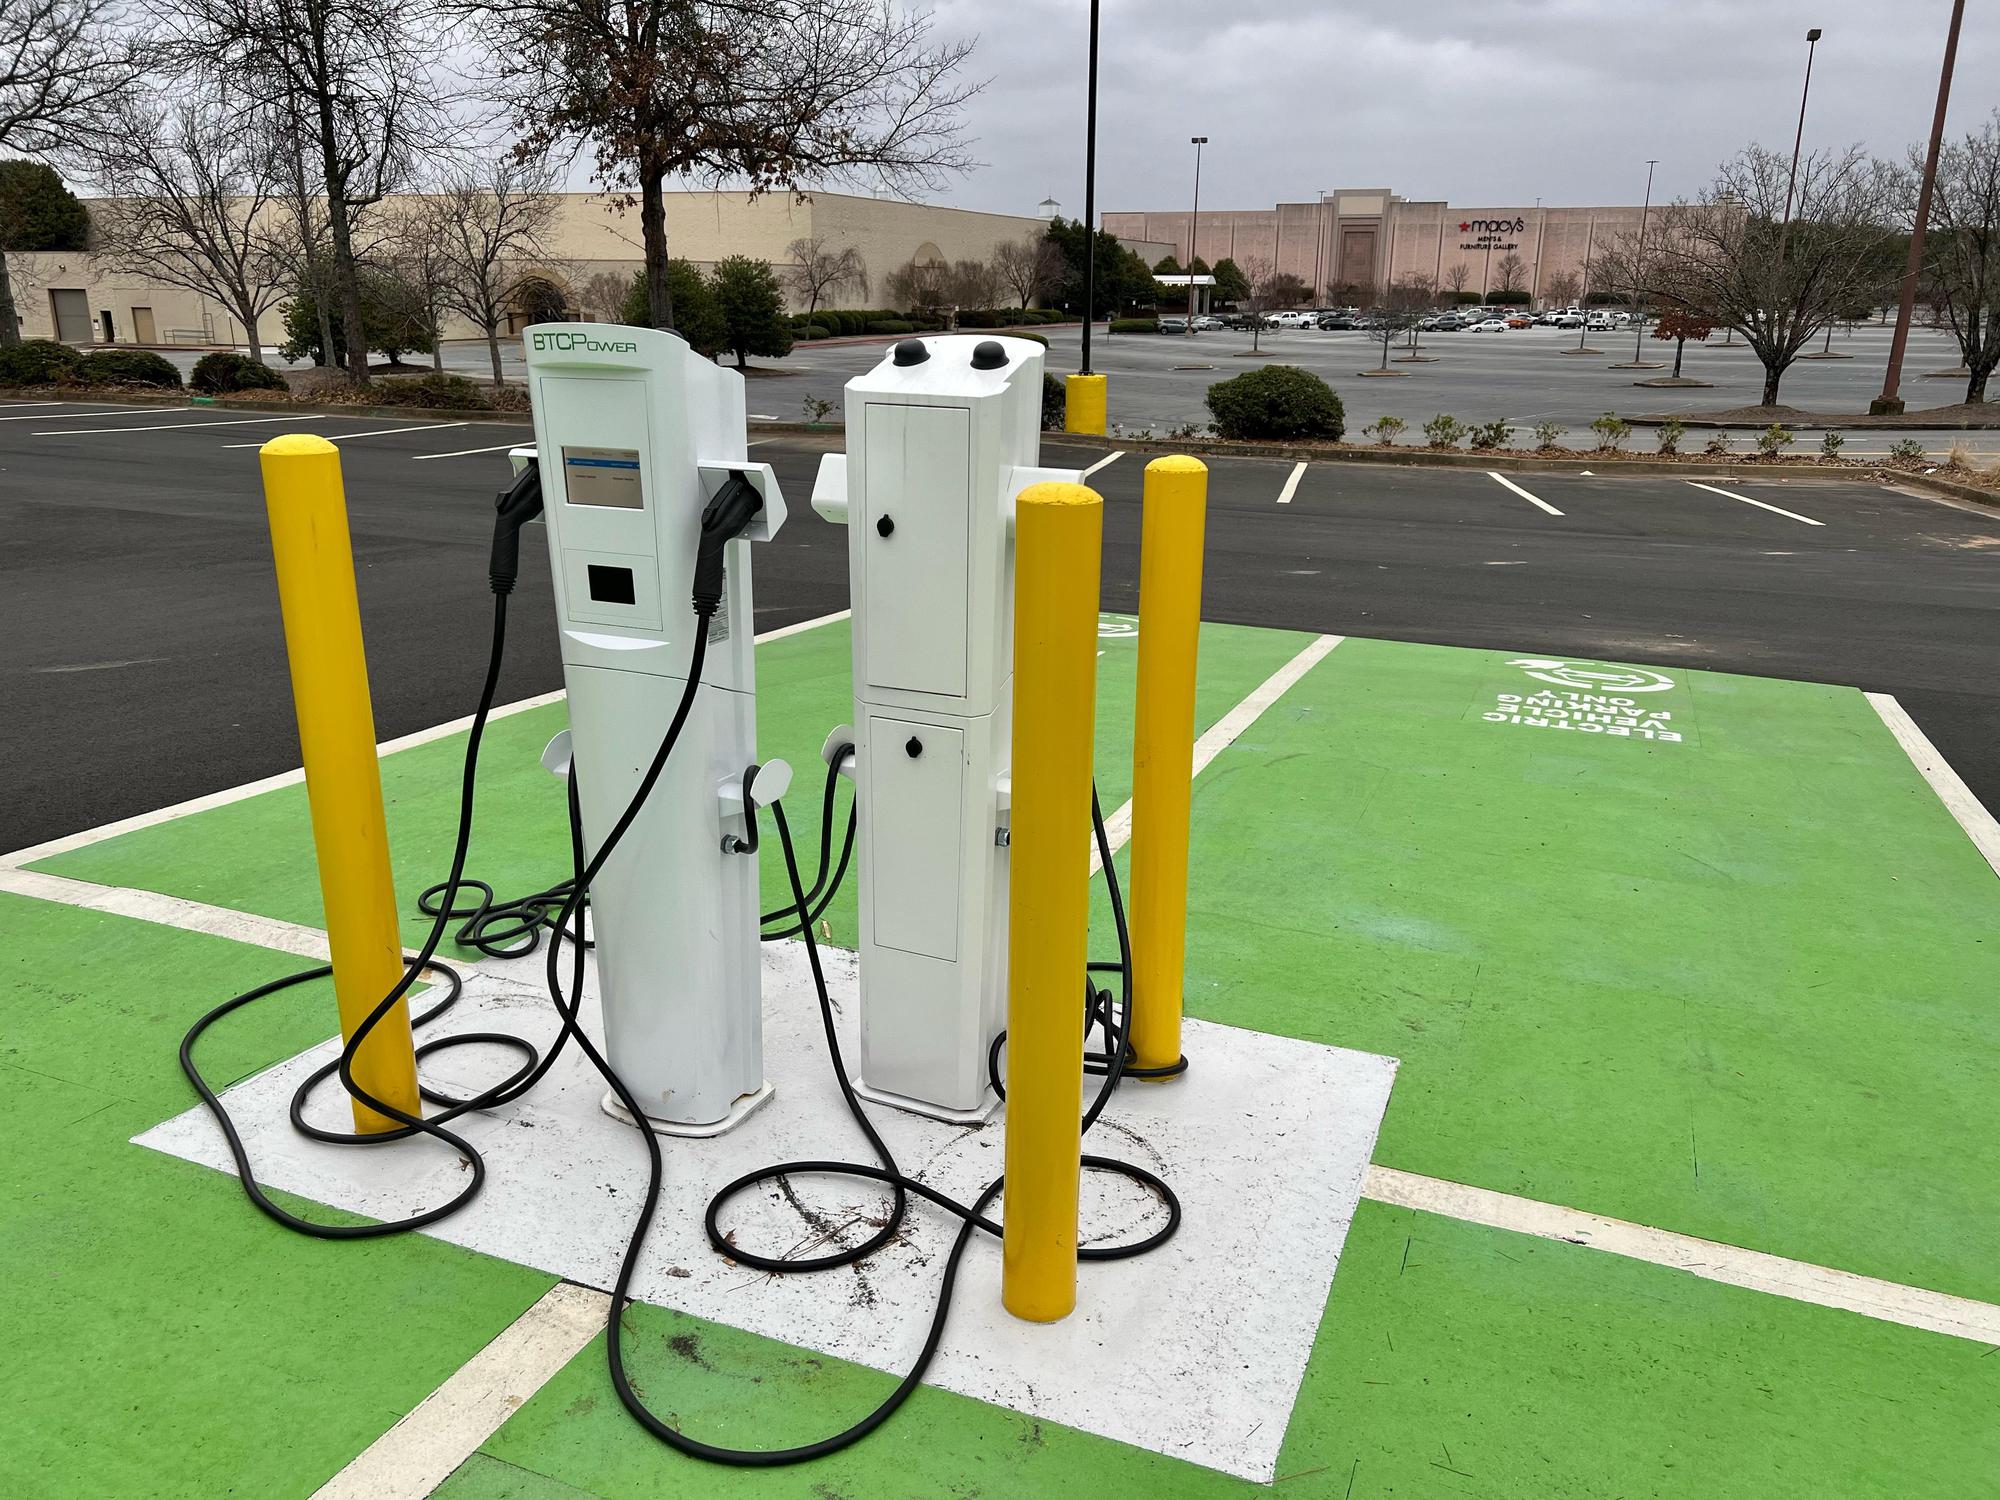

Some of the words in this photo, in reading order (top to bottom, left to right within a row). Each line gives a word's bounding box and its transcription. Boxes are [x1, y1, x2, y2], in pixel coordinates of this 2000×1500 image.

[1472, 217, 1524, 236] macy's
[1497, 694, 1671, 720] PARKING
[1534, 690, 1635, 706] ONLY
[1482, 712, 1682, 742] ELECTRIC
[1496, 704, 1668, 730] VEHICLE
